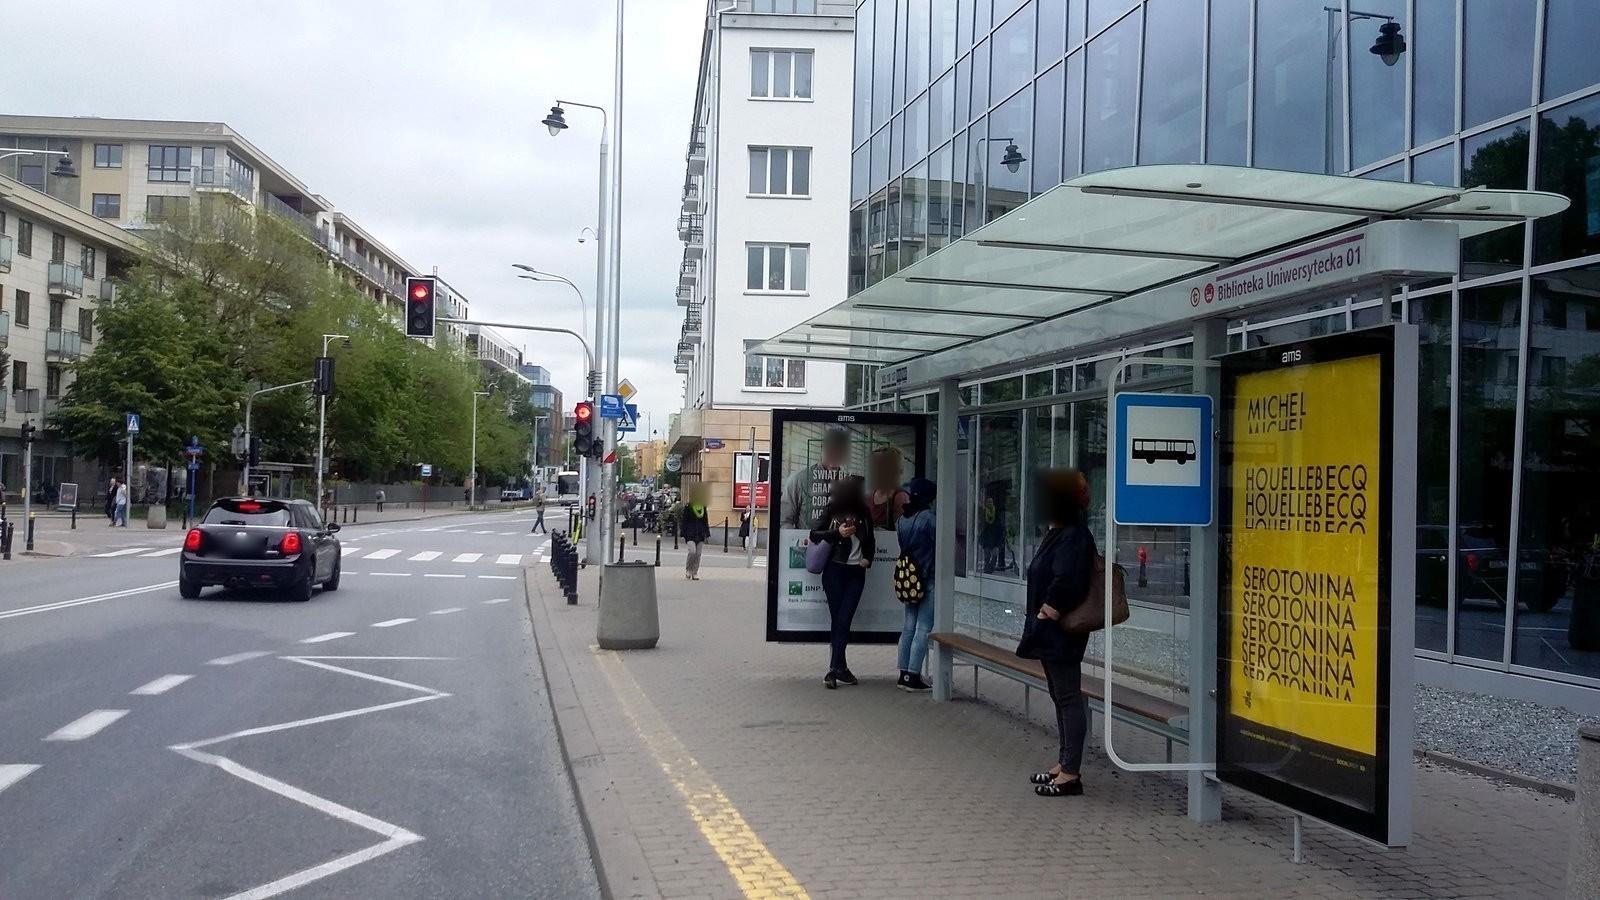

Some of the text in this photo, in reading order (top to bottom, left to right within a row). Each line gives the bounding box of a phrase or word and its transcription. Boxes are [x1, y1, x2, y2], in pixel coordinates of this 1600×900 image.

[1217, 277, 1264, 301] Biblioteka
[1266, 253, 1343, 287] Uniwersytecka
[1346, 246, 1361, 267] 01
[1281, 350, 1302, 363] ams
[1248, 392, 1307, 421] MICHEL
[1245, 464, 1368, 491] HOUELLEBECQ
[1245, 493, 1367, 520] HOUELLEBECQ
[1243, 565, 1357, 603] SEROTONINA
[1242, 591, 1357, 631] SEROTONINA
[1242, 616, 1356, 660] SEROTONINA
[1241, 640, 1356, 688] SEROTONINA
